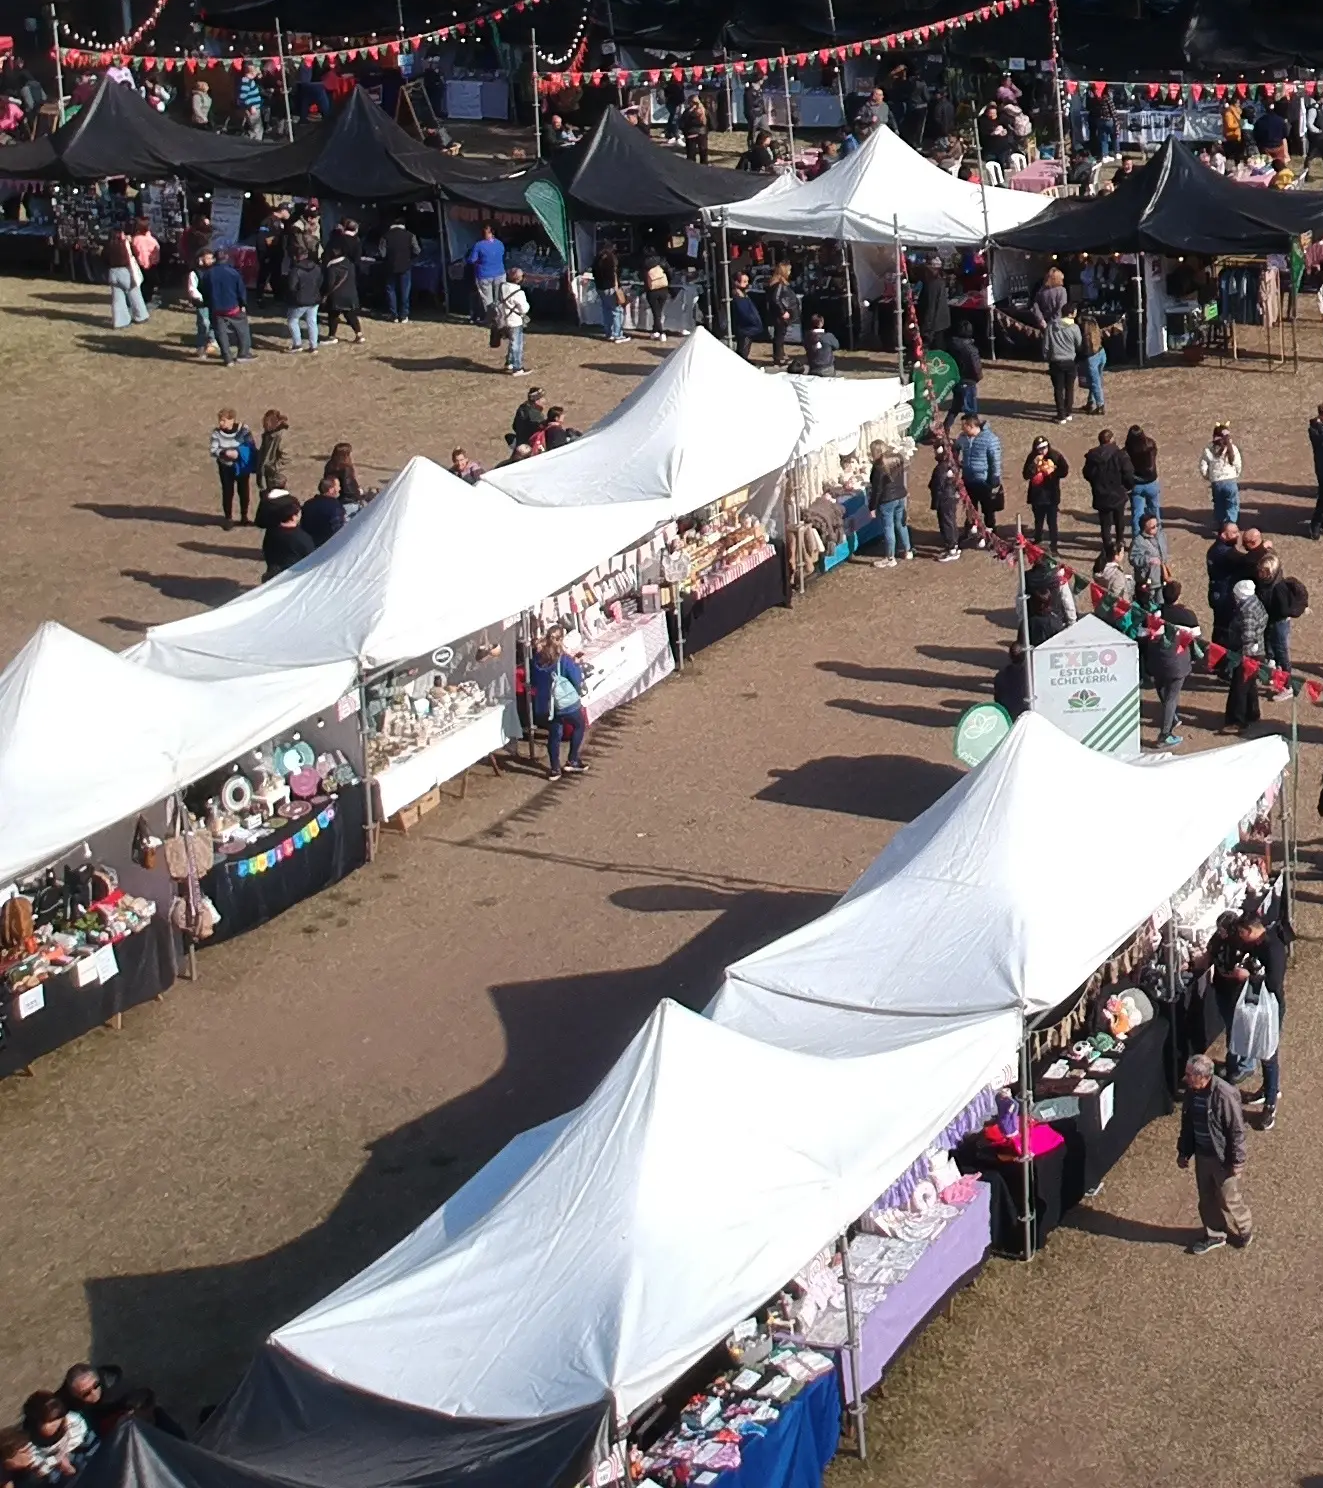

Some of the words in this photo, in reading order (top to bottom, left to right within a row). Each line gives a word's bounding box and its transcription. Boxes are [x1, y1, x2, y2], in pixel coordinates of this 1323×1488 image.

[1049, 649, 1118, 670] EXPO
[1059, 667, 1108, 678] ESTEBAN
[1050, 674, 1118, 686] ECHEVERRÍA
